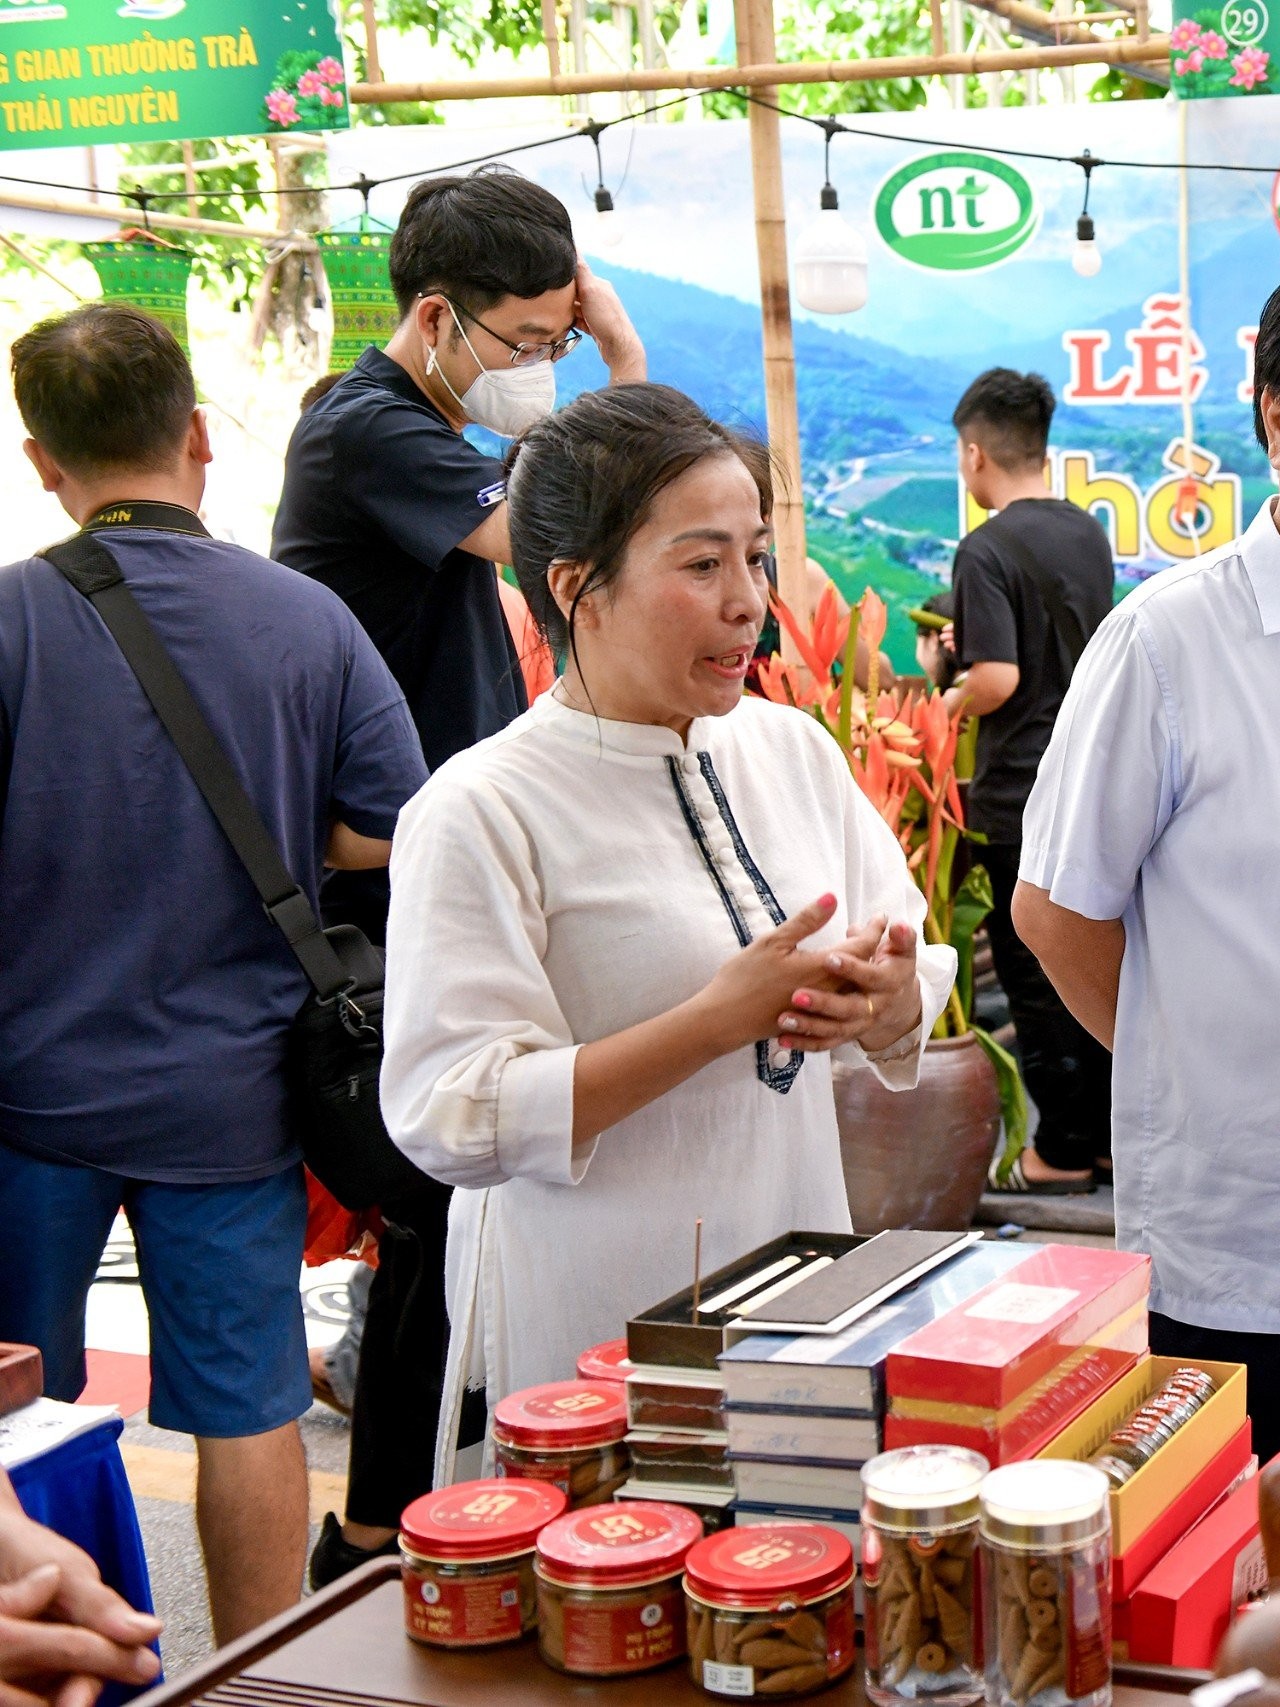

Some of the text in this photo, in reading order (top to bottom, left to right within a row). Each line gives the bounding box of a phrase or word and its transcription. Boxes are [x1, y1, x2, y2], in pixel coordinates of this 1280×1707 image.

[1227, 8, 1259, 36] 29
[15, 48, 82, 82] GIAN
[86, 30, 197, 77] THƯỞNG
[202, 26, 258, 69] TRÀ
[3, 84, 179, 132] THÁI NGUYÊN
[1069, 300, 1202, 398] LỄ
